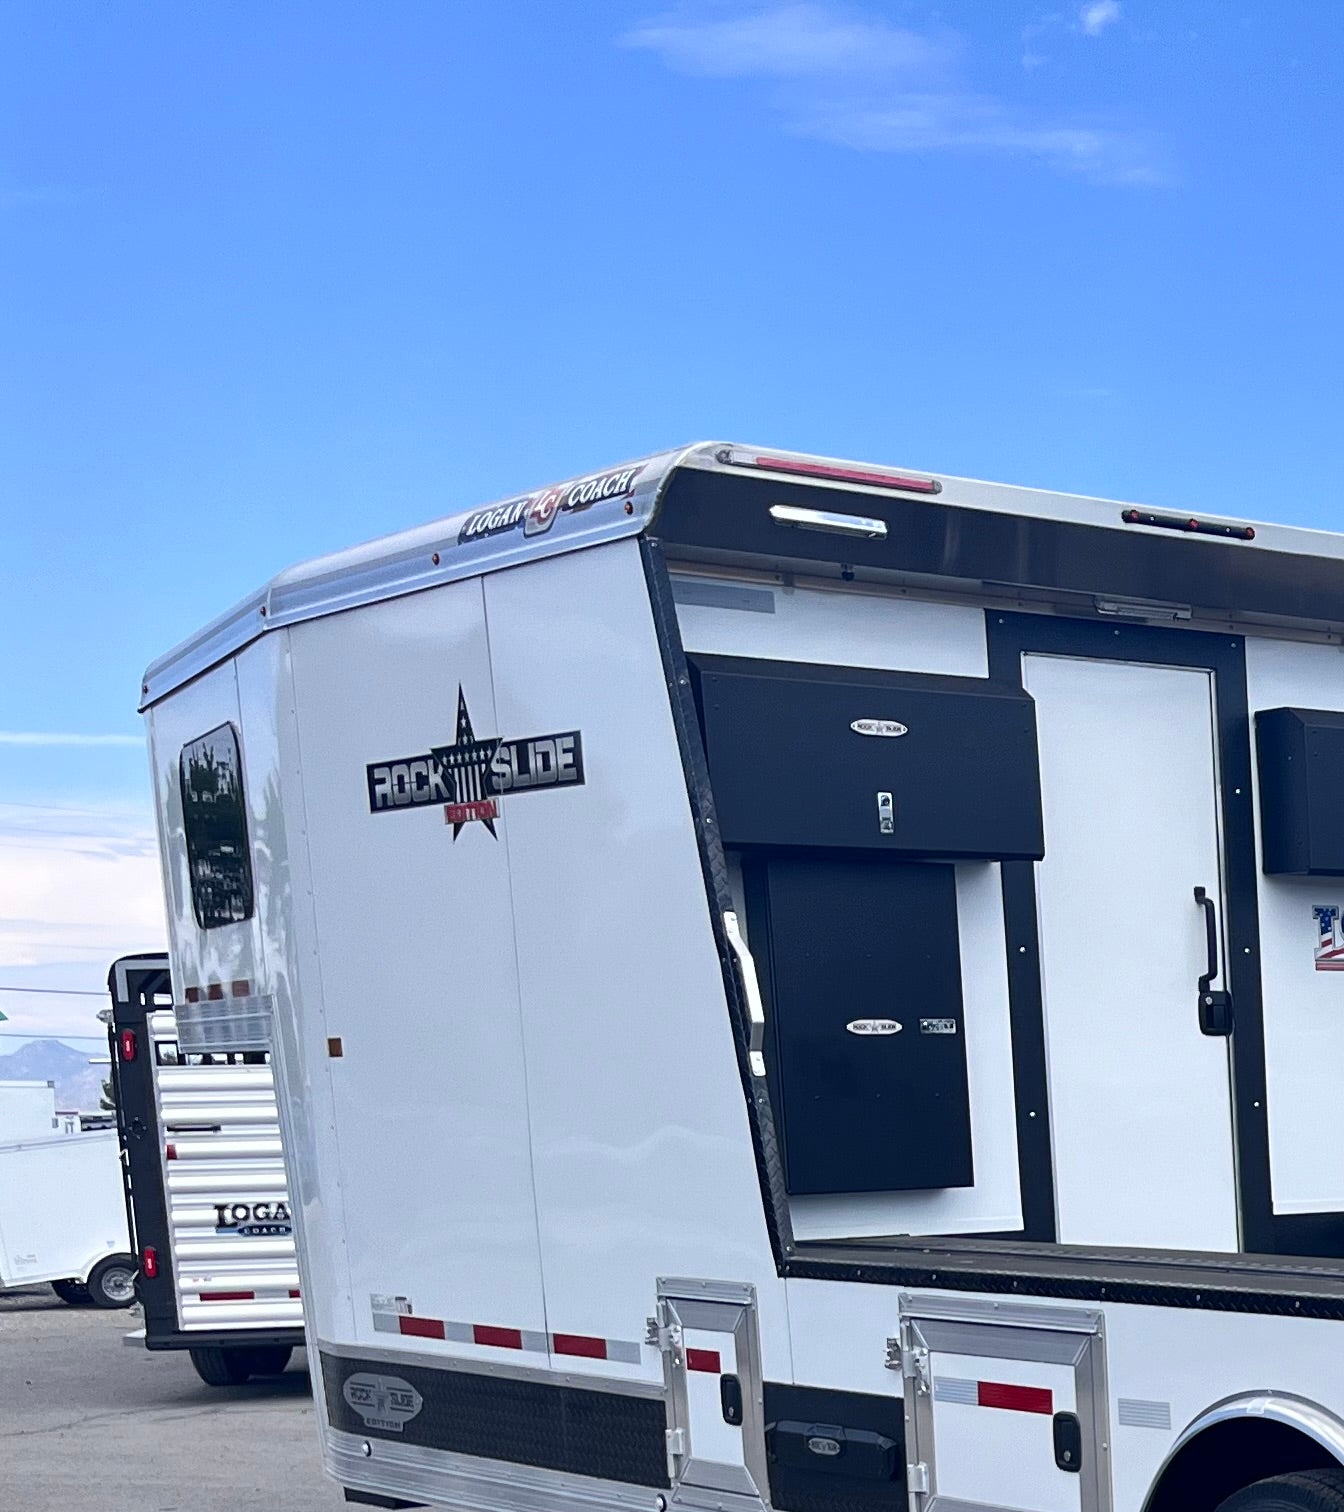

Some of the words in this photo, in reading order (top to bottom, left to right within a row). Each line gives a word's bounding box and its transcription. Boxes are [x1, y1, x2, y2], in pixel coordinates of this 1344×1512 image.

[465, 500, 528, 536] LOGAN
[567, 468, 637, 507] COACH
[373, 758, 452, 809] ROCK
[490, 735, 578, 791] SLIDE
